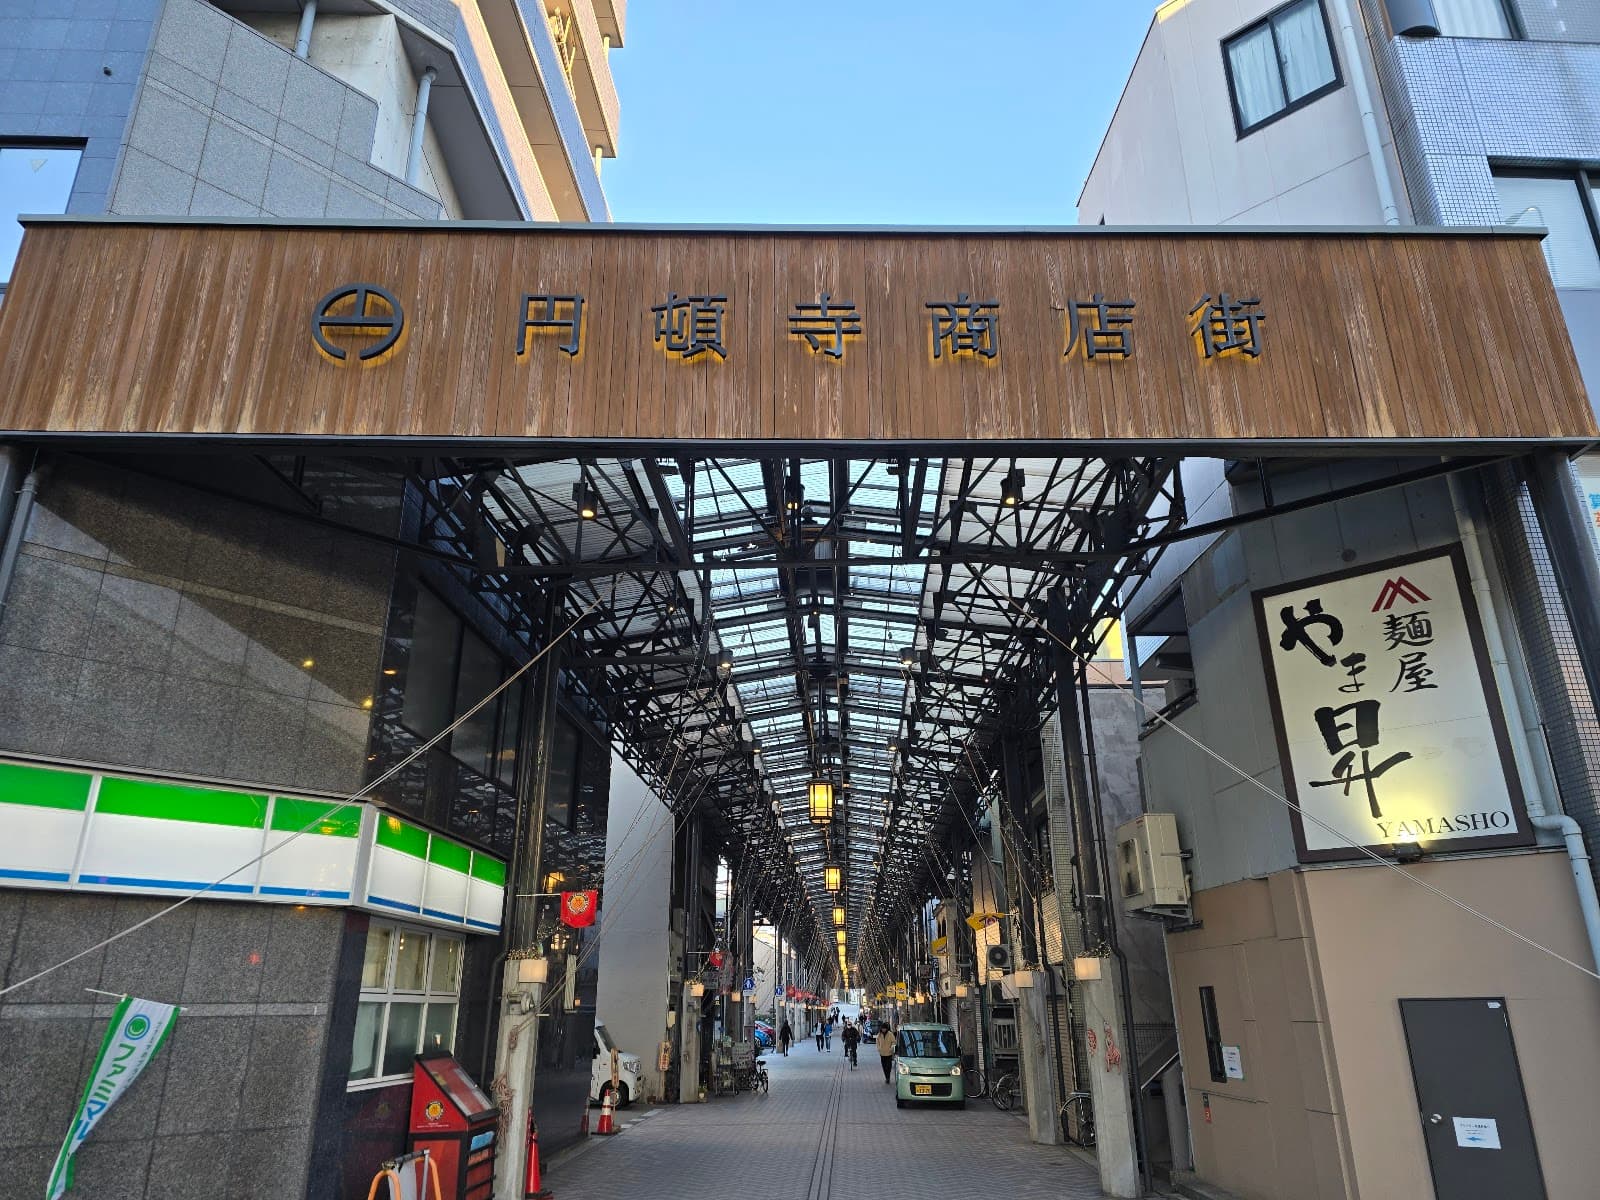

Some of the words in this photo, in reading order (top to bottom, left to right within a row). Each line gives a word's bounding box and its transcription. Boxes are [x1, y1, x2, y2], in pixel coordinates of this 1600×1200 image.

[516, 292, 1266, 359] 円頓寺商店街
[1382, 611, 1438, 693] 麺屋
[1279, 598, 1413, 818] やま昇
[1377, 810, 1510, 838] YAMASHO
[74, 1043, 137, 1141] ファミマル
